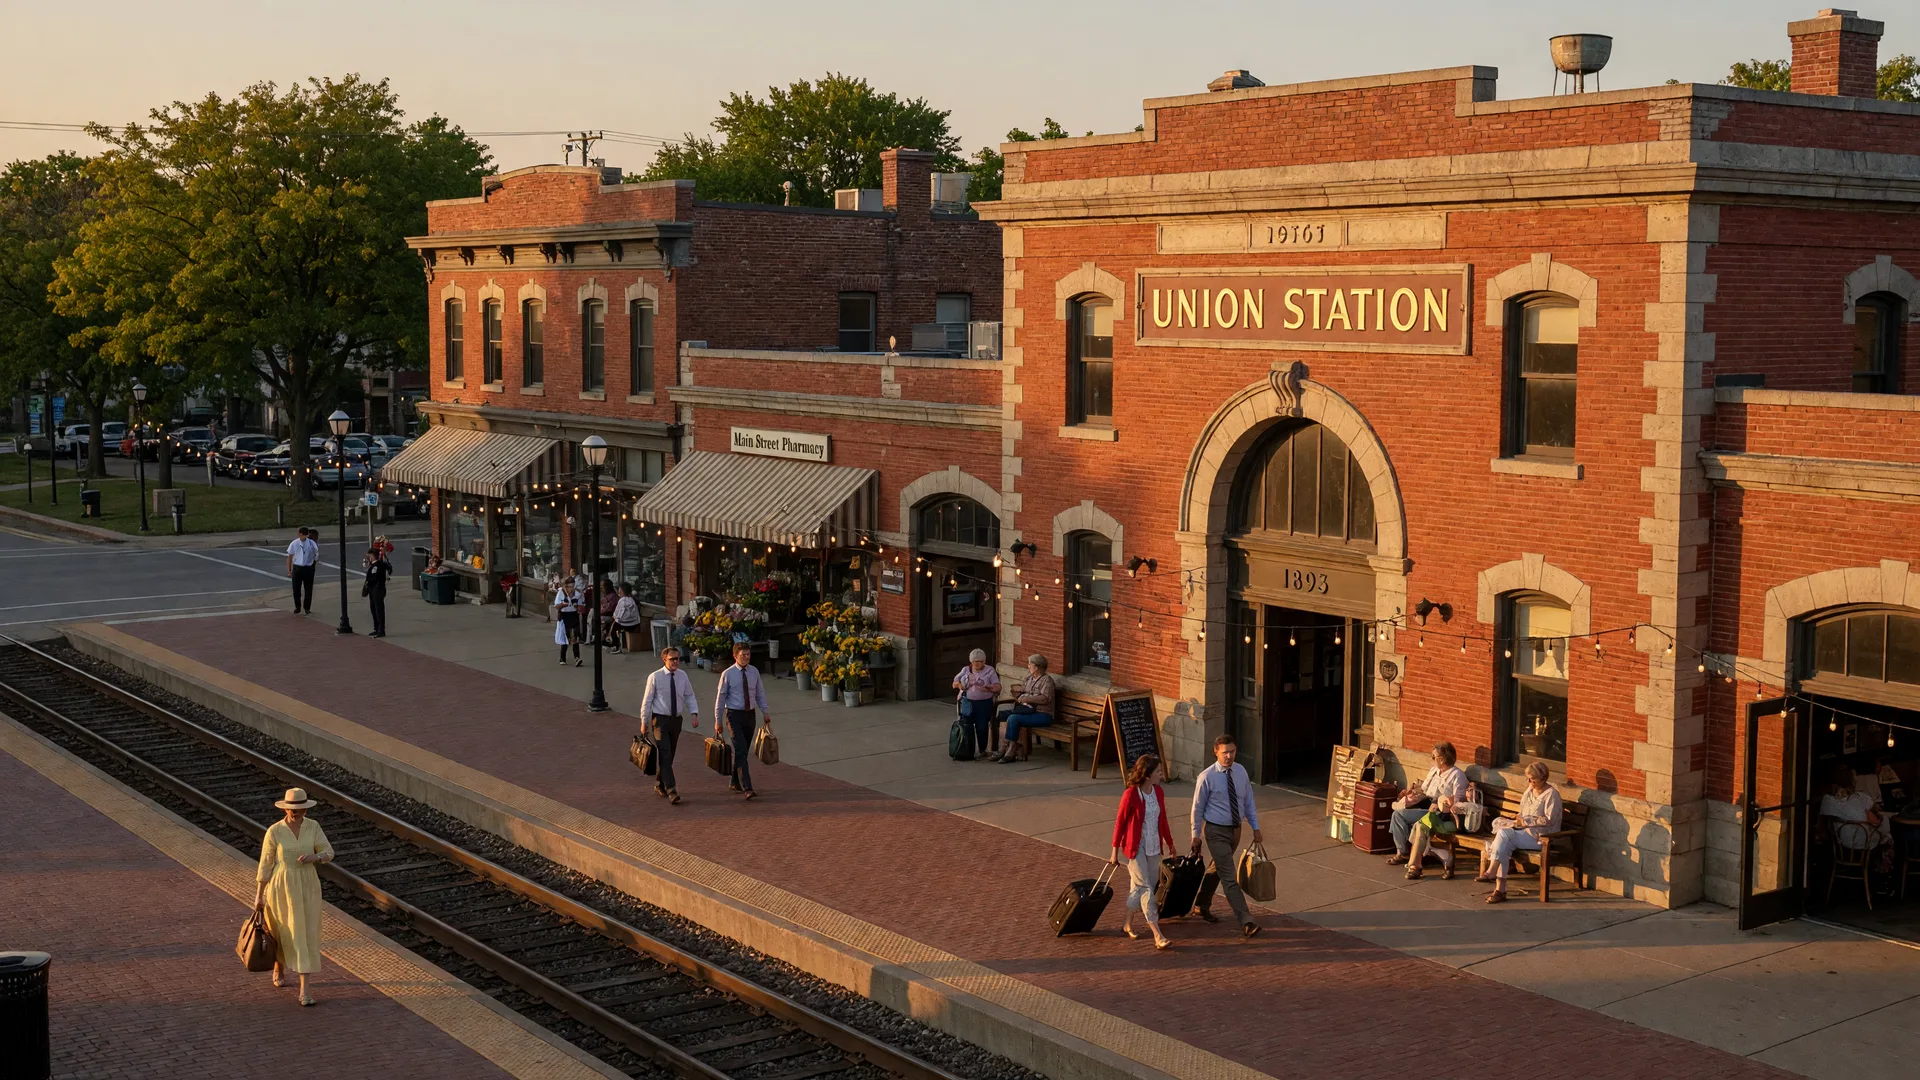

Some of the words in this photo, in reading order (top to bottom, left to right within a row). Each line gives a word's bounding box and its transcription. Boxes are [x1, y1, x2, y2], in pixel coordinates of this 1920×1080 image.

[1153, 287, 1264, 328] UNION
[1283, 287, 1450, 332] STATION
[734, 432, 754, 448] Main
[755, 434, 780, 451] Street
[782, 437, 824, 459] Pharmacy
[1284, 568, 1329, 595] 1893
